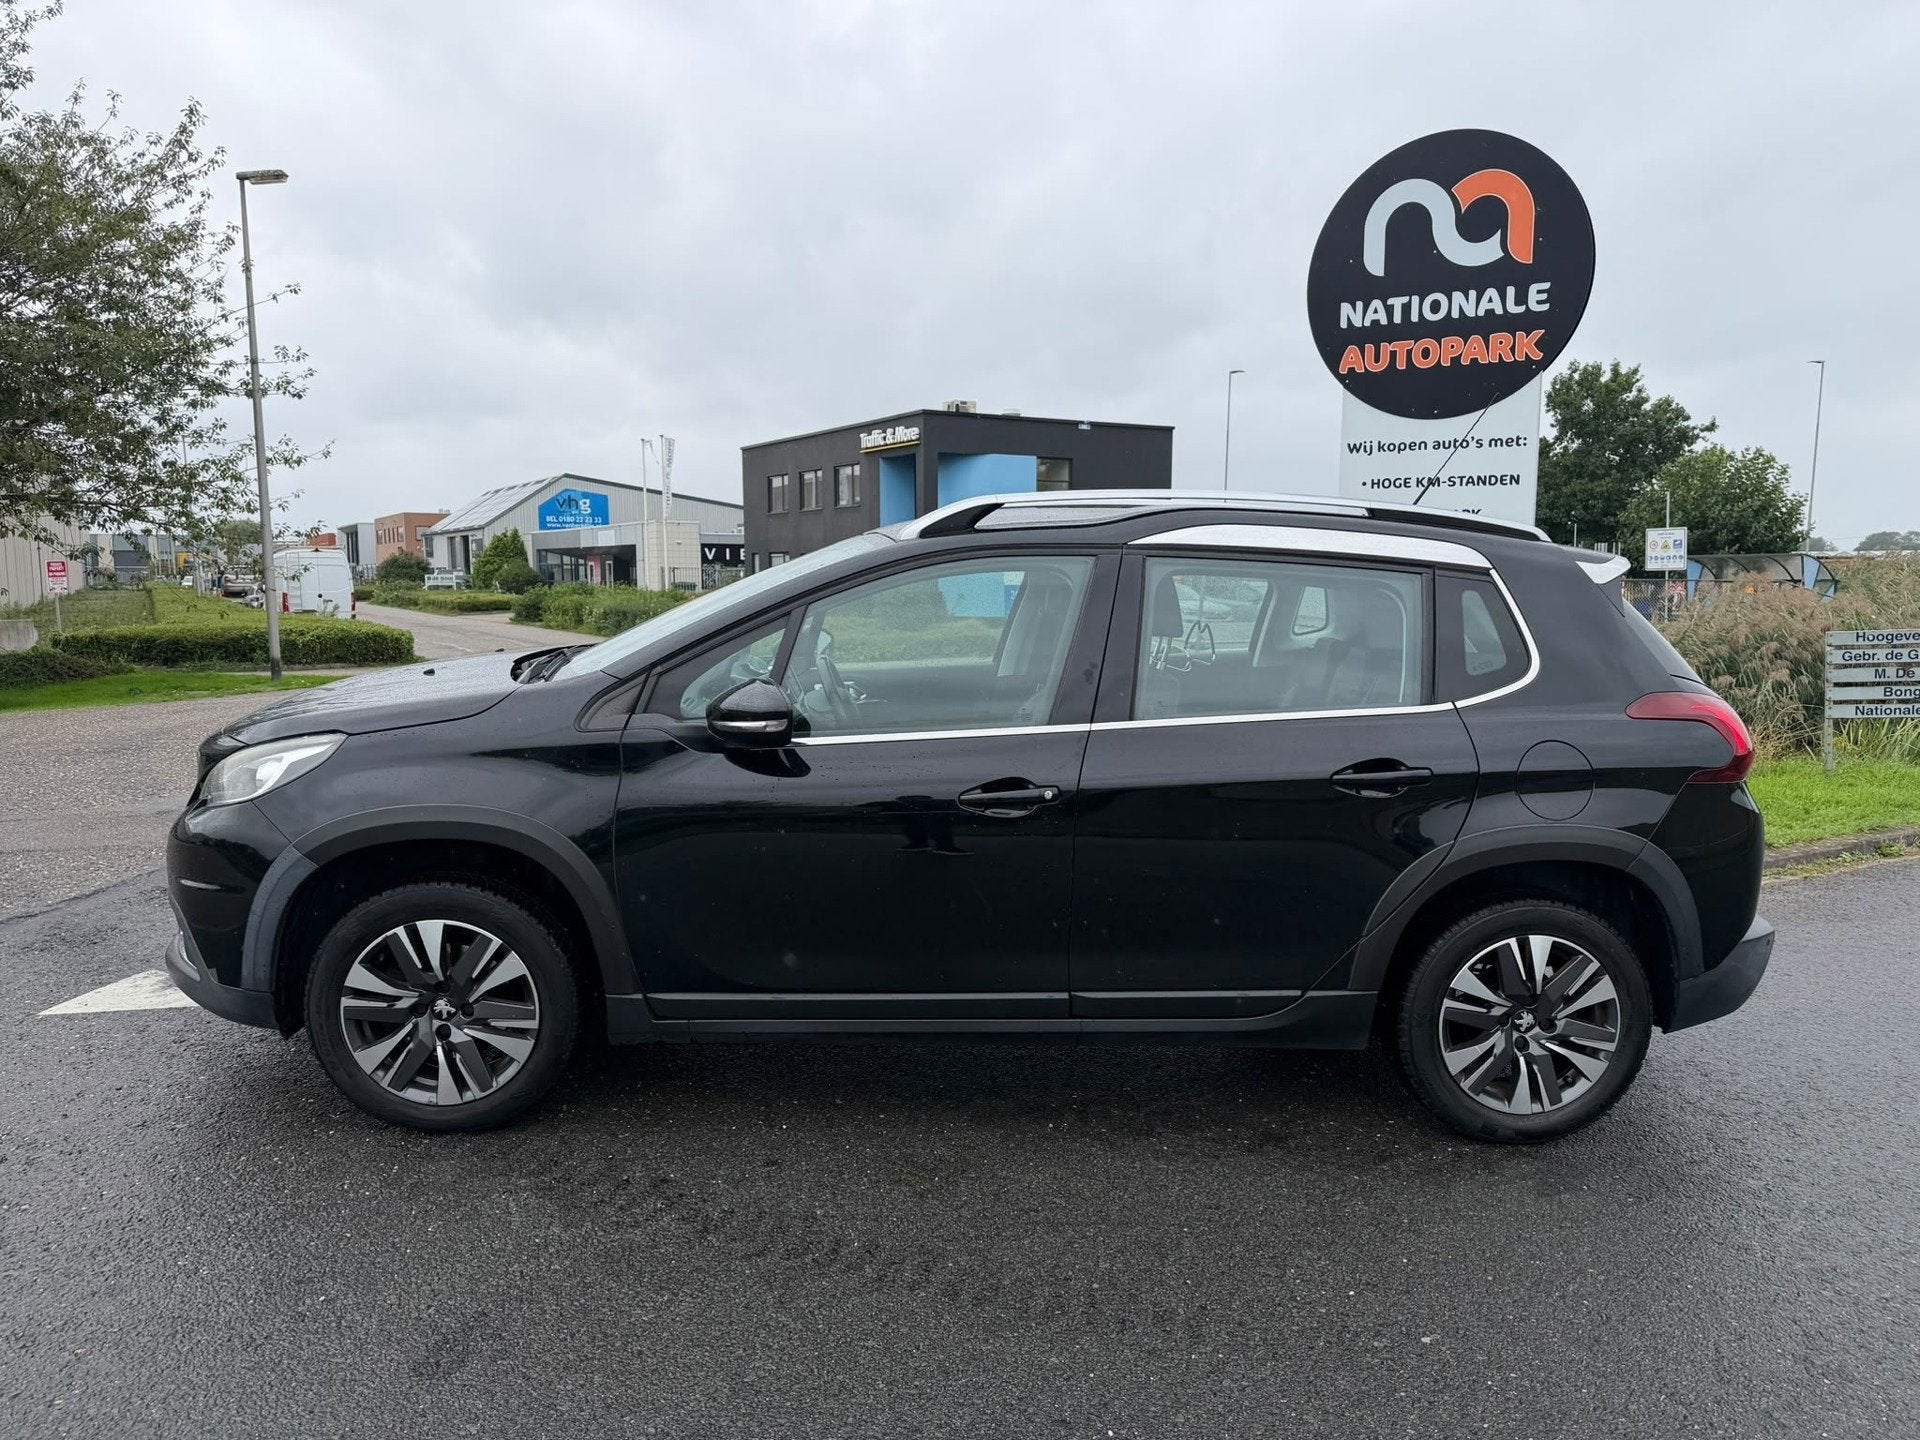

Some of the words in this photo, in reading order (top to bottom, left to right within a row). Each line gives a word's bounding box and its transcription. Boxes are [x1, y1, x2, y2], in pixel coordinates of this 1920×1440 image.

[1340, 282, 1551, 329] NATIONALE
[1339, 330, 1546, 374] AUTOPARK
[859, 429, 886, 448] Traffic
[886, 428, 895, 445] &
[895, 426, 920, 443] More
[1347, 441, 1373, 456] Wij
[1377, 440, 1428, 454] kopen
[1432, 436, 1484, 450] auto's
[1488, 435, 1527, 448] met:
[1370, 477, 1412, 489] HOGE
[1416, 474, 1521, 488] KM-STANDEN
[556, 494, 591, 514] vhg
[545, 515, 558, 523] BEL
[1842, 651, 1880, 661] Gebr.
[1885, 650, 1904, 660] de
[1874, 669, 1890, 679] M.
[1896, 668, 1915, 678] De
[1883, 687, 1920, 699] Bong
[1855, 705, 1920, 716] Nationale
